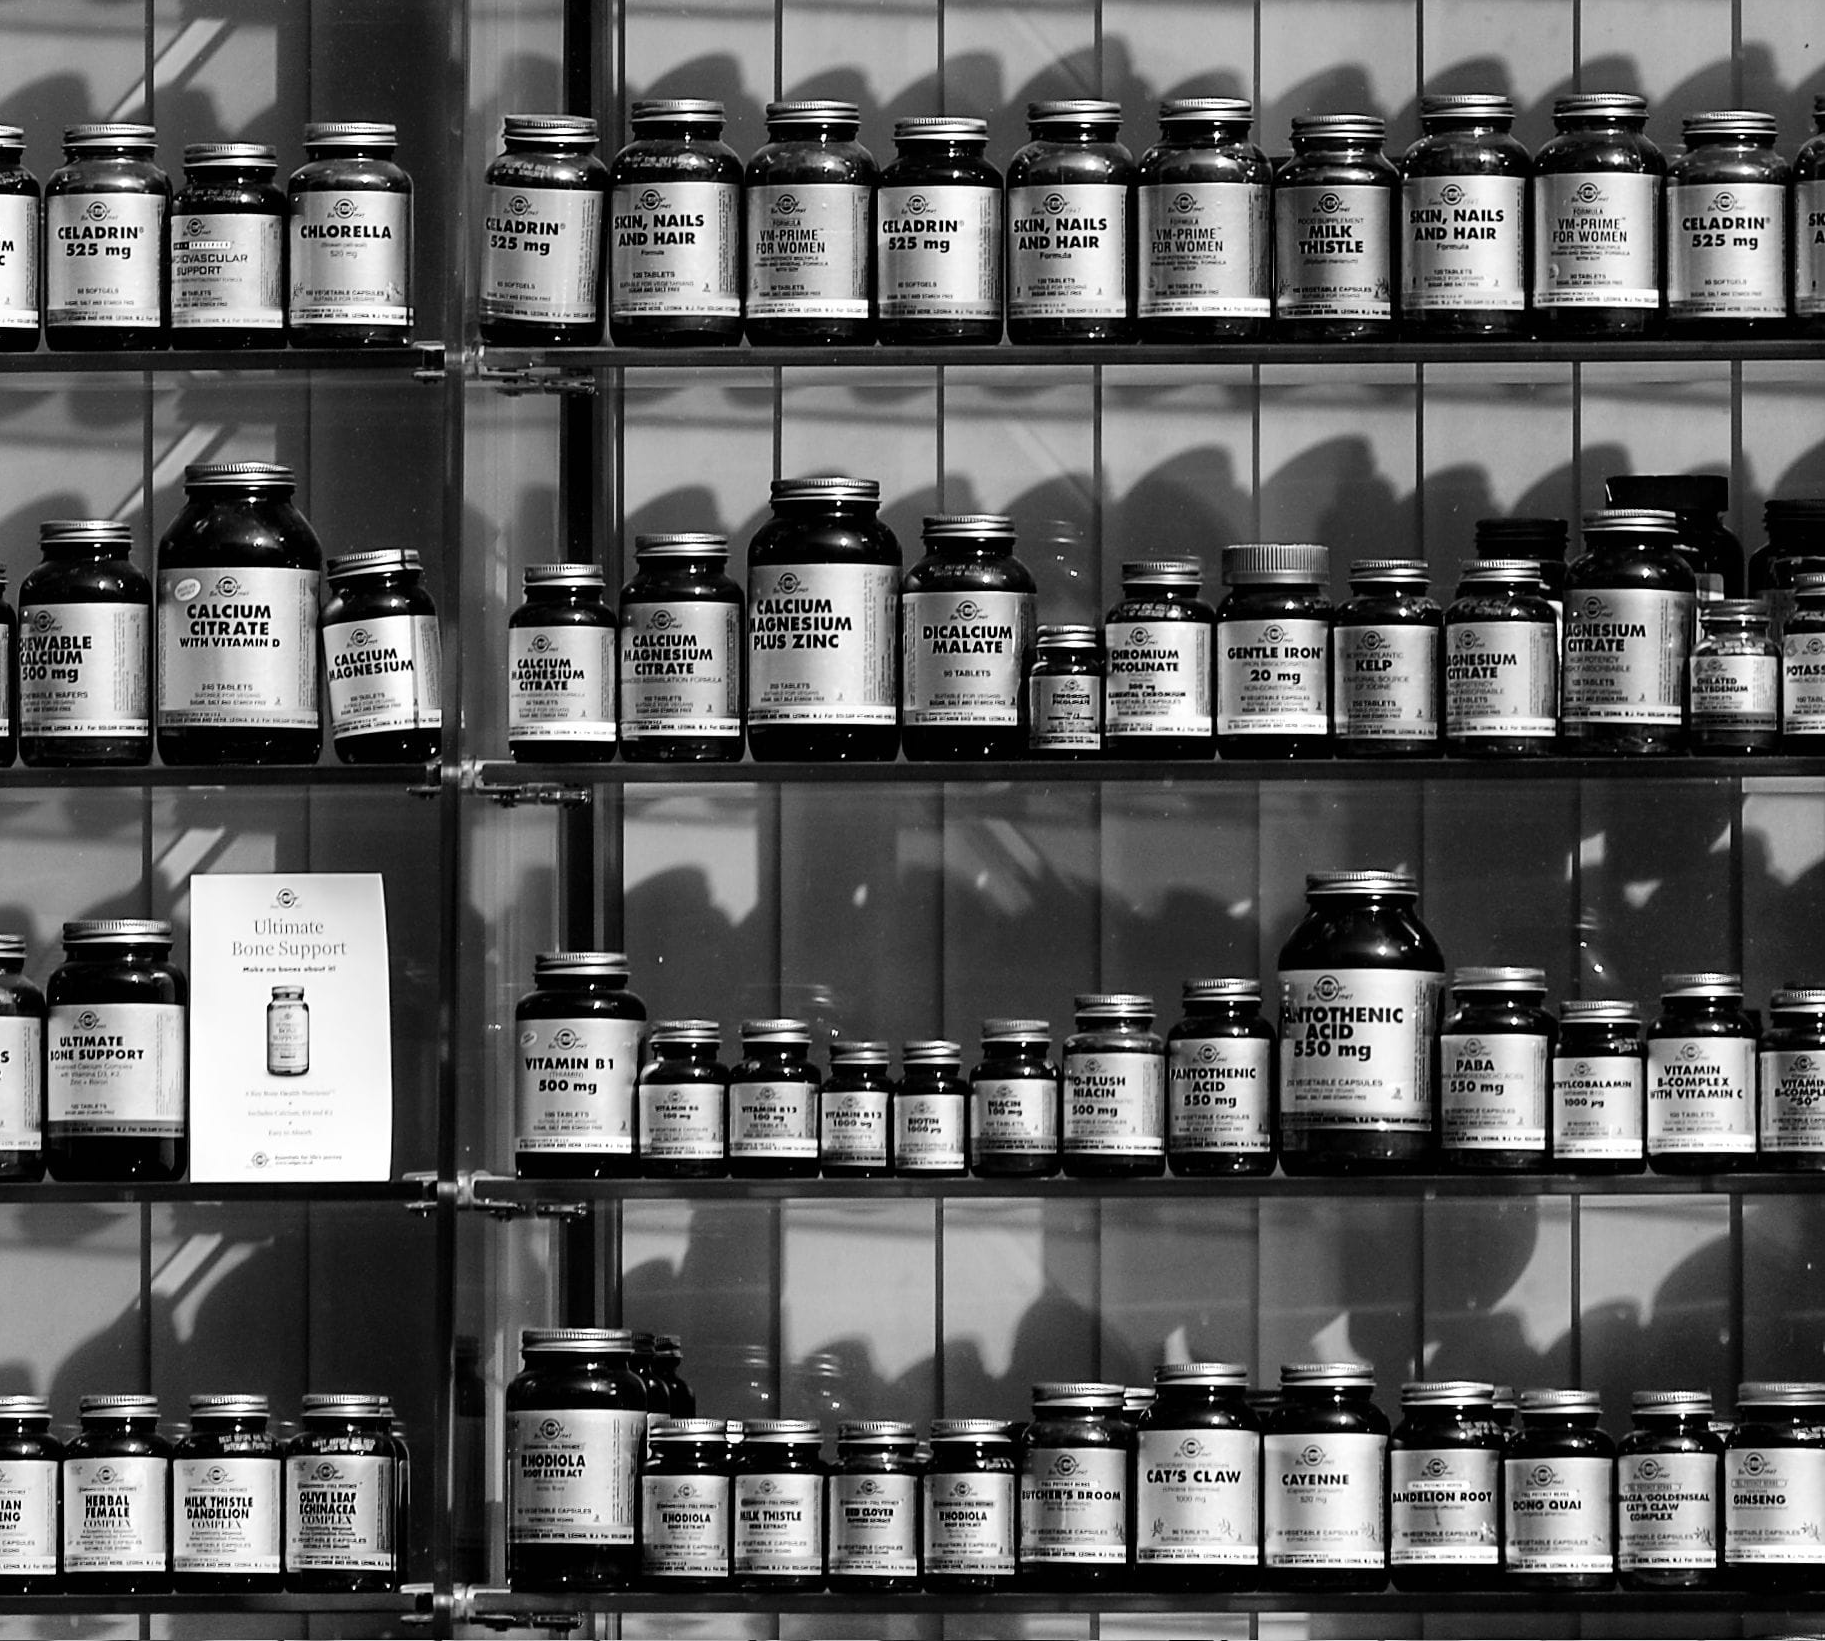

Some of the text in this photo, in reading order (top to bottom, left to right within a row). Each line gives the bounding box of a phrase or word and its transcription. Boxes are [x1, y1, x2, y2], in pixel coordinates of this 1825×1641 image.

[1309, 224, 1352, 238] MILK
[756, 240, 825, 254] FOR WOMEN
[1299, 240, 1363, 255] THISTLE
[187, 604, 271, 619] CALCIUM
[190, 621, 269, 635] CITRATE
[923, 625, 1012, 640] DICALCIUM
[180, 637, 280, 648] WITH VITAMIN D
[933, 640, 1002, 654] MALATE
[1228, 646, 1278, 659] GENTLE
[1251, 669, 1300, 685] 20 mg
[255, 918, 323, 934] Ultimate
[233, 942, 345, 959] Bone Support
[1306, 1021, 1353, 1042] ACID
[60, 1036, 123, 1047] ULTIMATE
[79, 1049, 143, 1060] SUPPORT
[1294, 1040, 1371, 1061] 550 mg
[526, 1057, 588, 1070] VITAMIN
[1456, 1059, 1494, 1072] PABA
[539, 1079, 597, 1095] 500 mg
[522, 1454, 585, 1467] RHODIOLA
[544, 1467, 582, 1478] EXTRACT
[1193, 1470, 1241, 1483] CLAW
[1282, 1474, 1348, 1485] CAYENNE
[86, 1495, 129, 1509] HERBAL
[185, 1496, 252, 1510] MILK THISTLE
[300, 1491, 356, 1505] OLIVE LEAF
[1734, 1494, 1786, 1505] GINSENG
[86, 1505, 129, 1519] FEMALE
[185, 1506, 248, 1519] DANDELION
[300, 1502, 356, 1517] ECHINACEA
[84, 1520, 130, 1528] COMPLEX
[192, 1520, 241, 1529] COMPLEX
